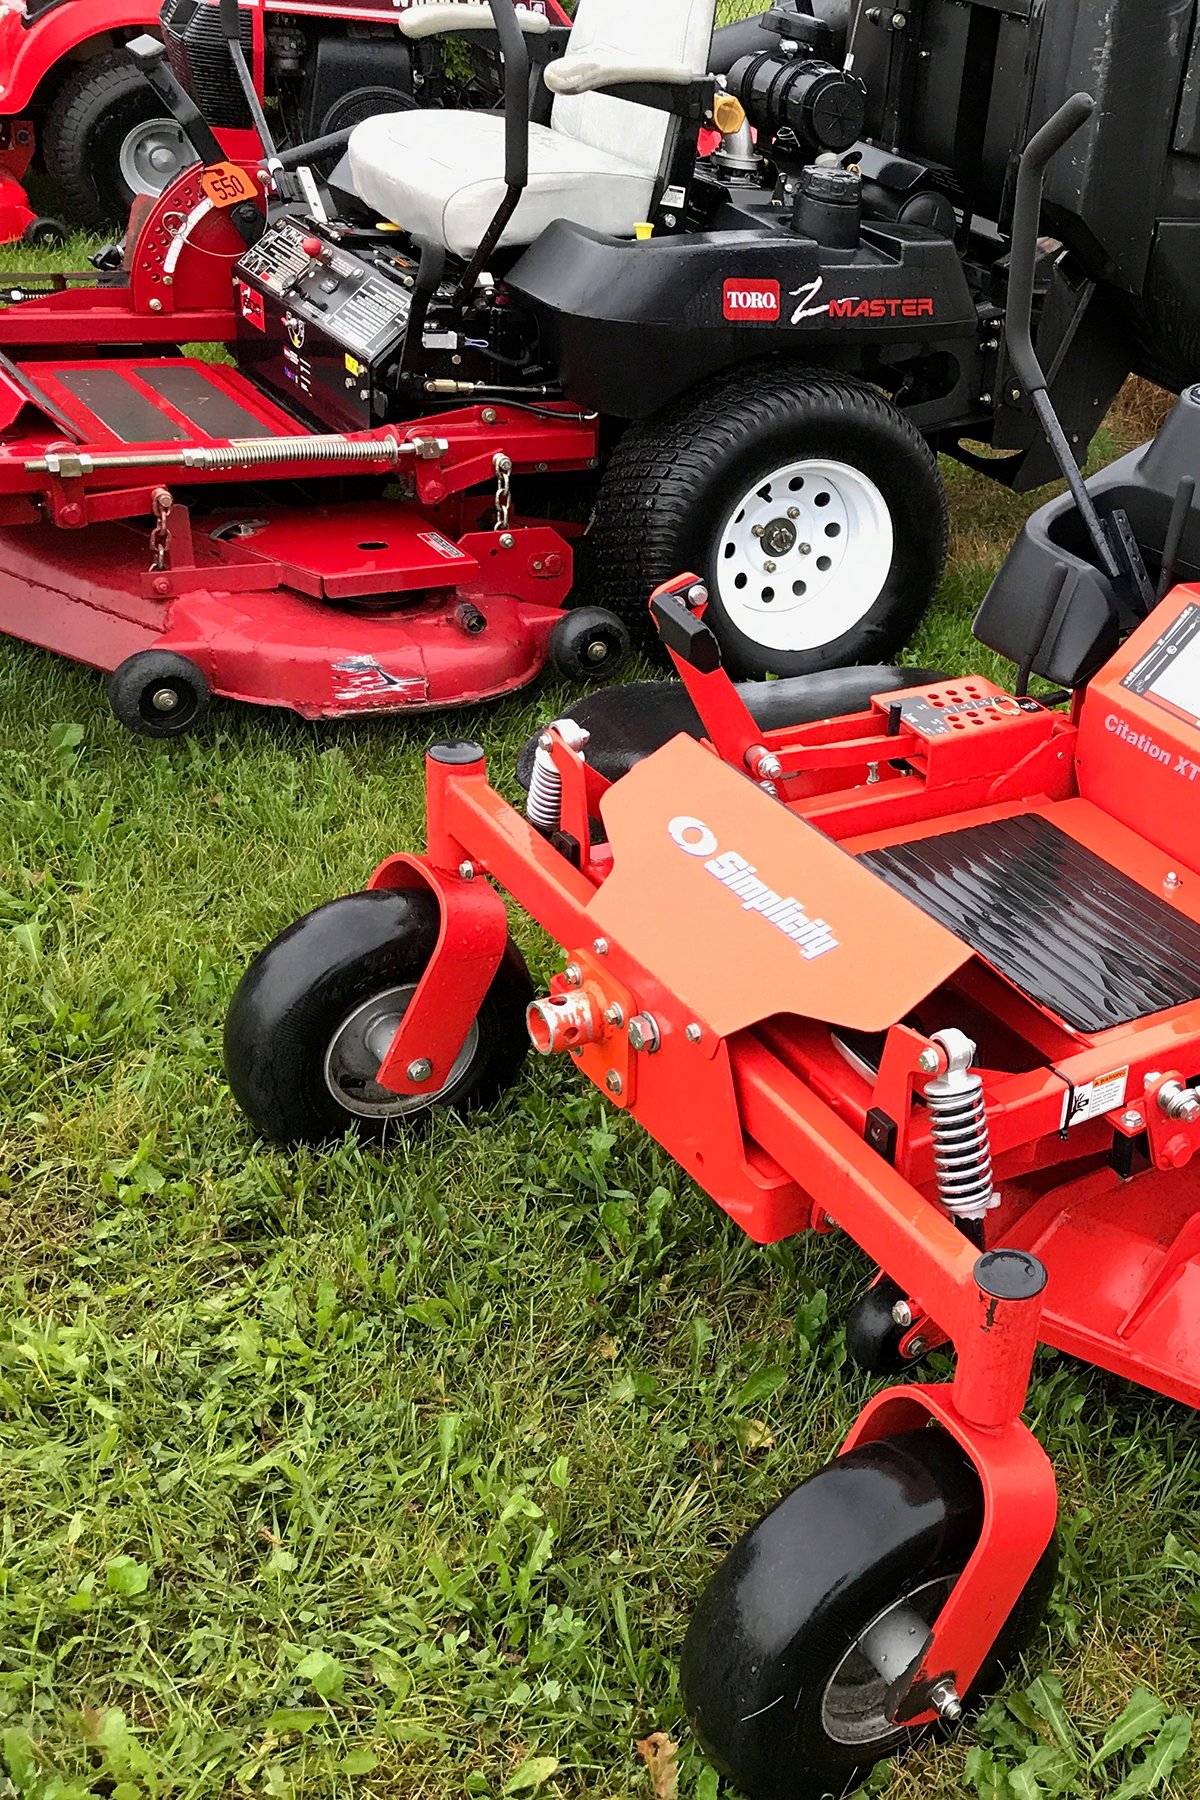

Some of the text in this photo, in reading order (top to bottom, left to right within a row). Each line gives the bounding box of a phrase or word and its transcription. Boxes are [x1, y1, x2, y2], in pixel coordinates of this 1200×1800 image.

[211, 175, 245, 200] 550
[727, 291, 776, 309] TORO
[829, 298, 934, 318] MASTER
[1104, 714, 1172, 766] Citation
[704, 850, 840, 961] Simplicity
